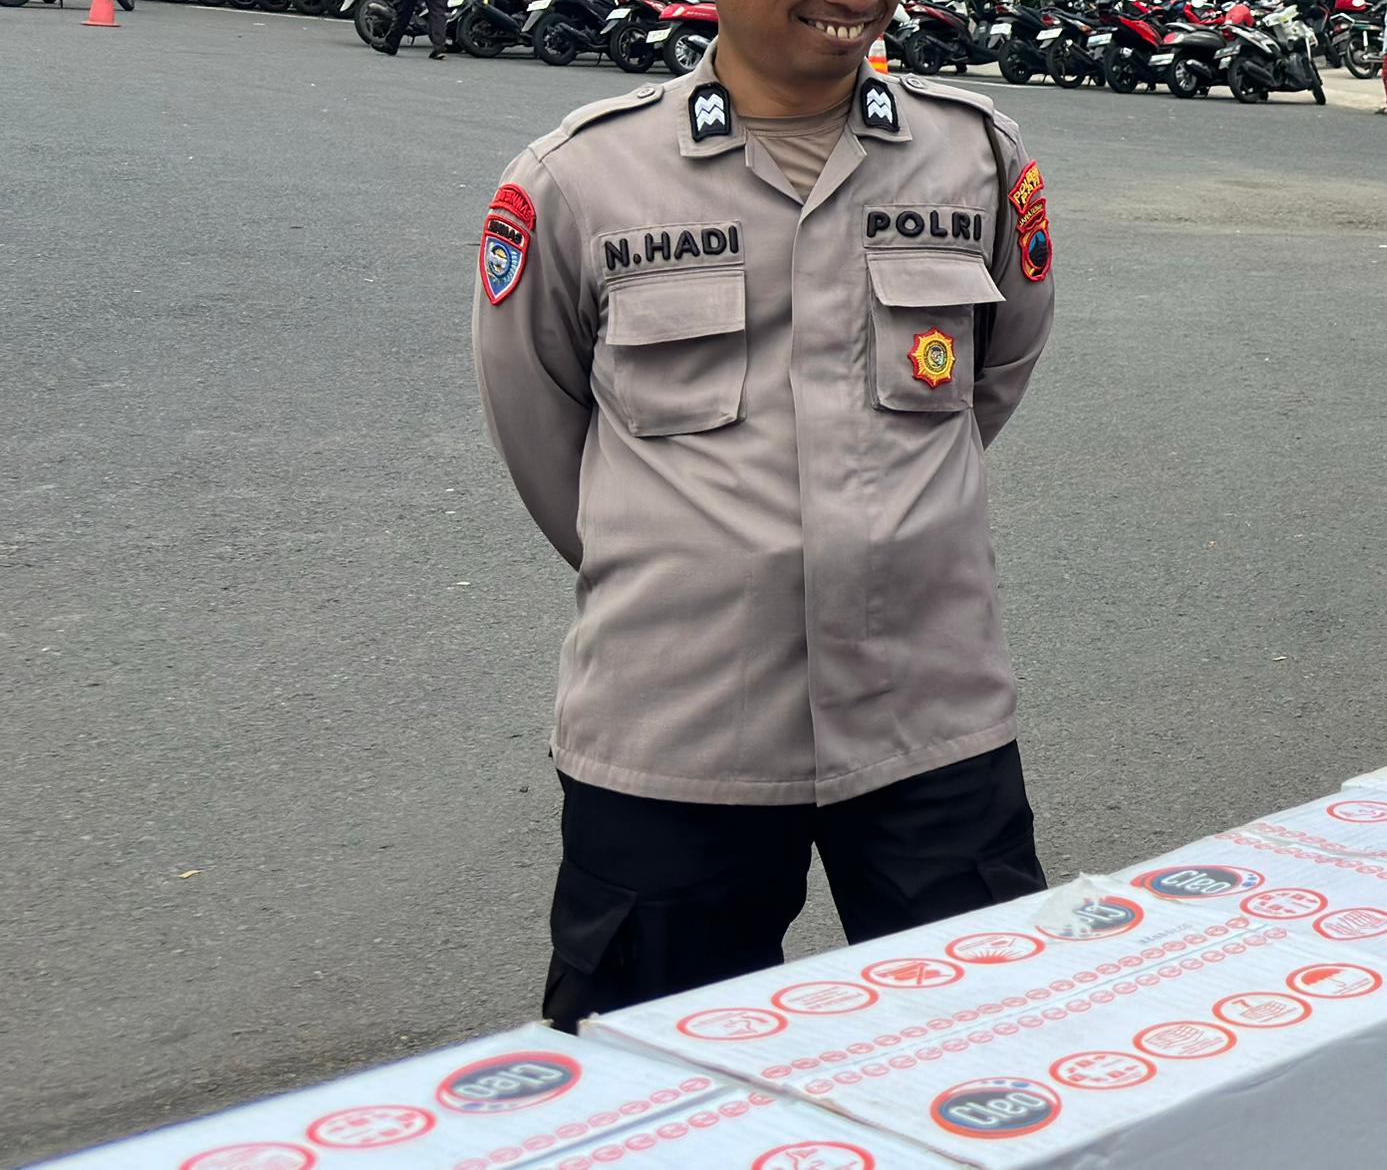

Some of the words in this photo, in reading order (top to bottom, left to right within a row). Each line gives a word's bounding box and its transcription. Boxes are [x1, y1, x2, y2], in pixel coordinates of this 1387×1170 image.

[867, 210, 982, 240] POLRI
[605, 226, 738, 270] N.HADI
[1161, 870, 1231, 894] Cleo
[459, 1063, 564, 1099] Cleo
[950, 1092, 1044, 1126] Cleo
